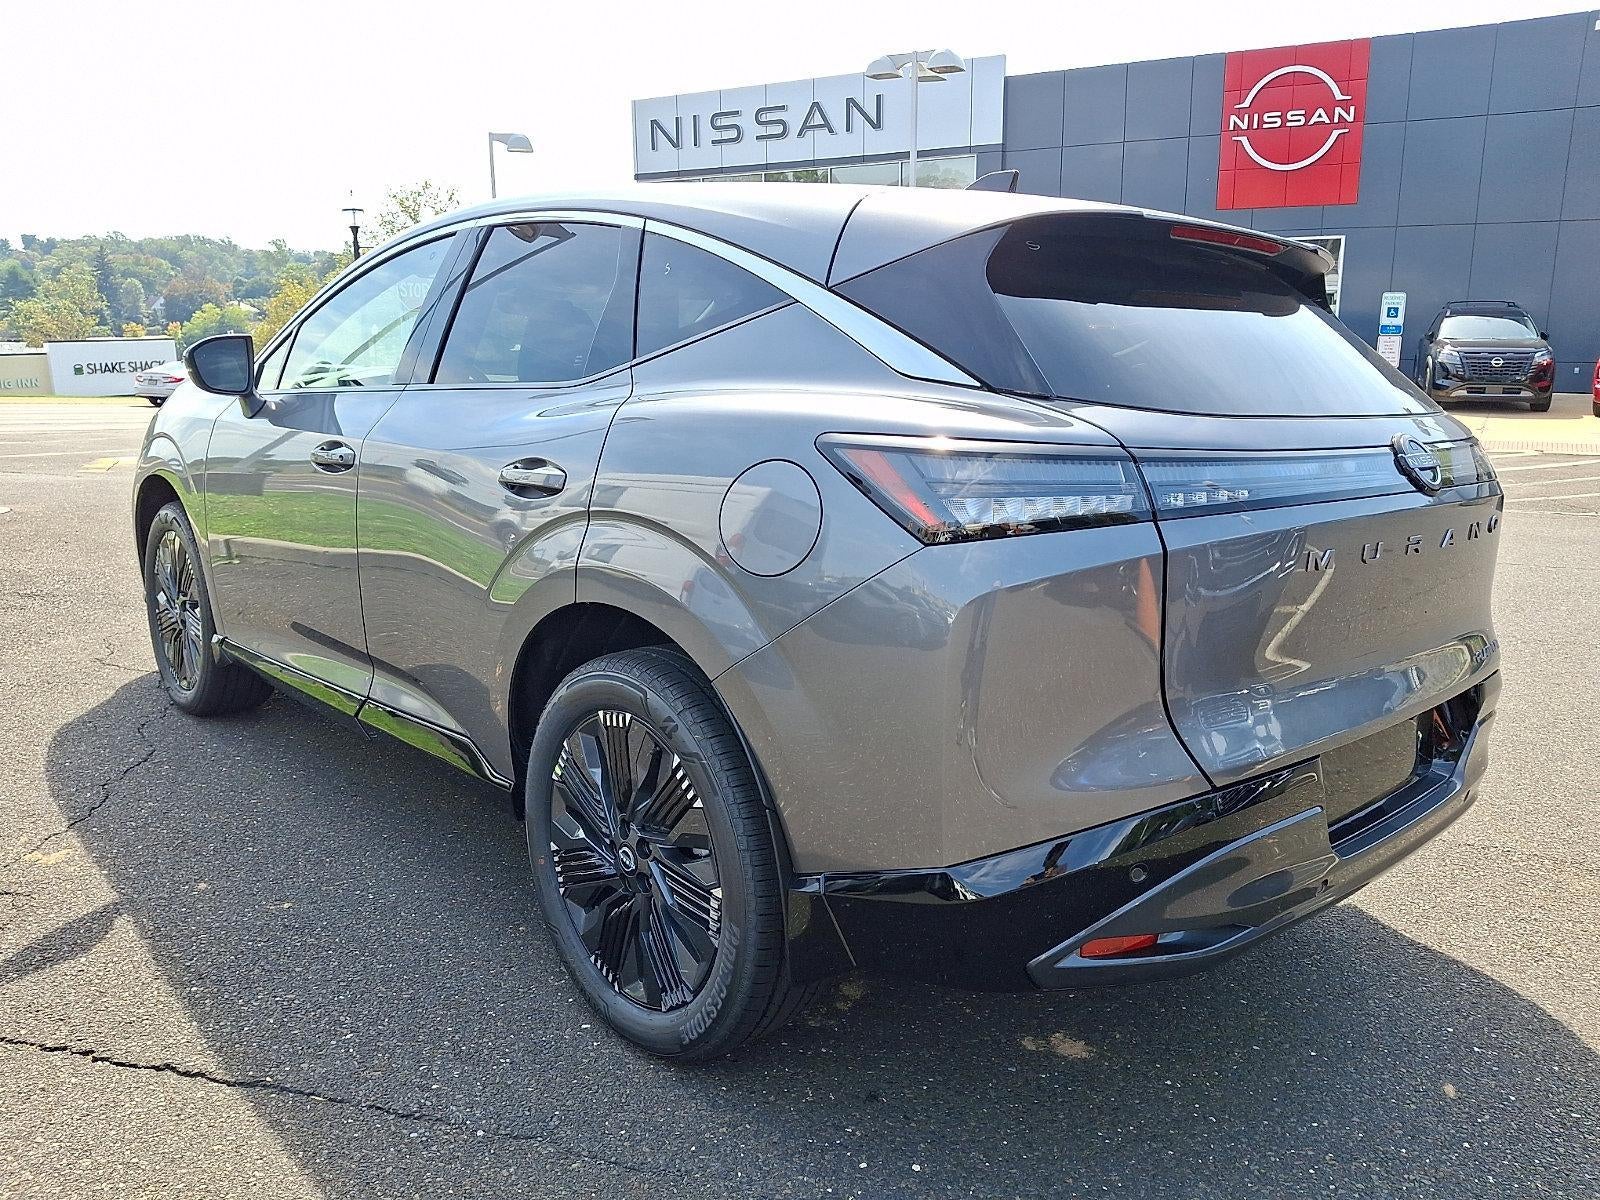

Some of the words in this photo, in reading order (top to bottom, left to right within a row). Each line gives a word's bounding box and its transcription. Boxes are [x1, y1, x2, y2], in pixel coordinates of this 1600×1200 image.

[649, 93, 884, 152] NISSAN
[1229, 105, 1356, 131] NISSAN
[86, 361, 127, 375] SHAKE
[1305, 515, 1499, 572] MURANO
